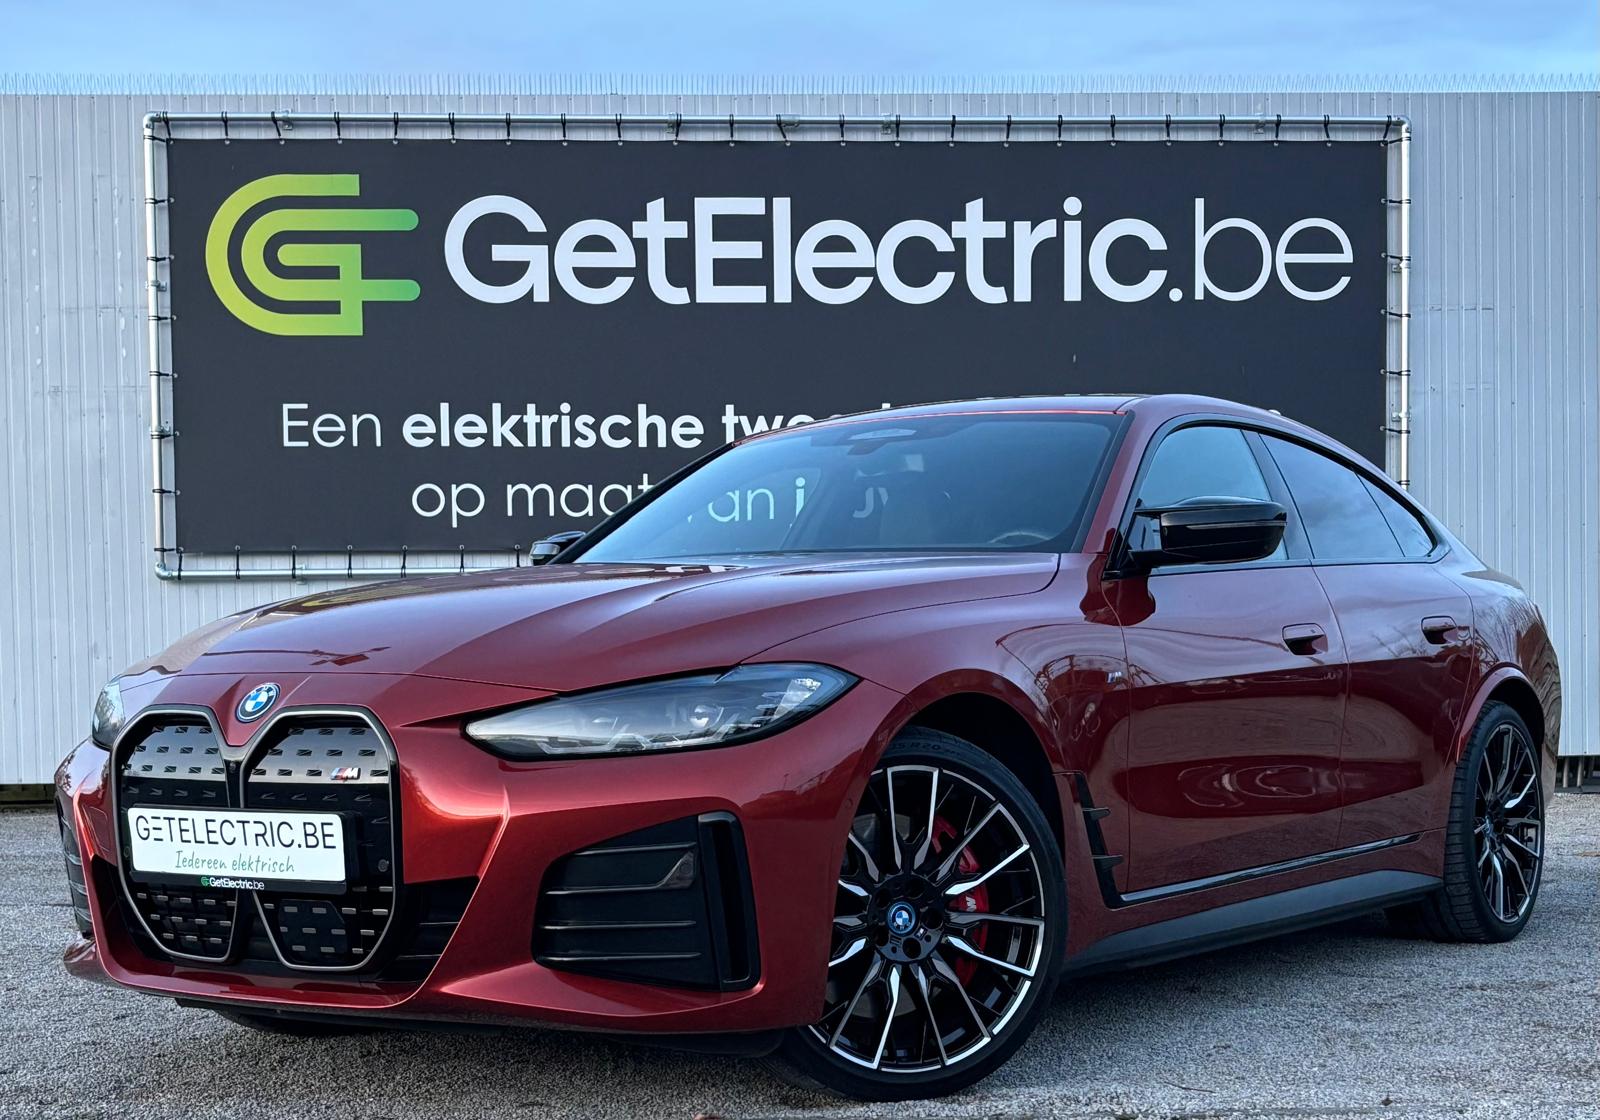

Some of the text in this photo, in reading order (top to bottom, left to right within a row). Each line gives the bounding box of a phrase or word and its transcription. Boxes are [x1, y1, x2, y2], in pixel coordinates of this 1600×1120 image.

[444, 195, 1354, 305] GetElectric.be
[283, 404, 381, 447] Een
[402, 402, 704, 449] elektrische
[412, 483, 485, 528] op
[135, 815, 336, 849] GETELECTRIC.BE
[175, 850, 295, 873] Iedereen elektrisch
[208, 876, 265, 891] GetElectric.be
